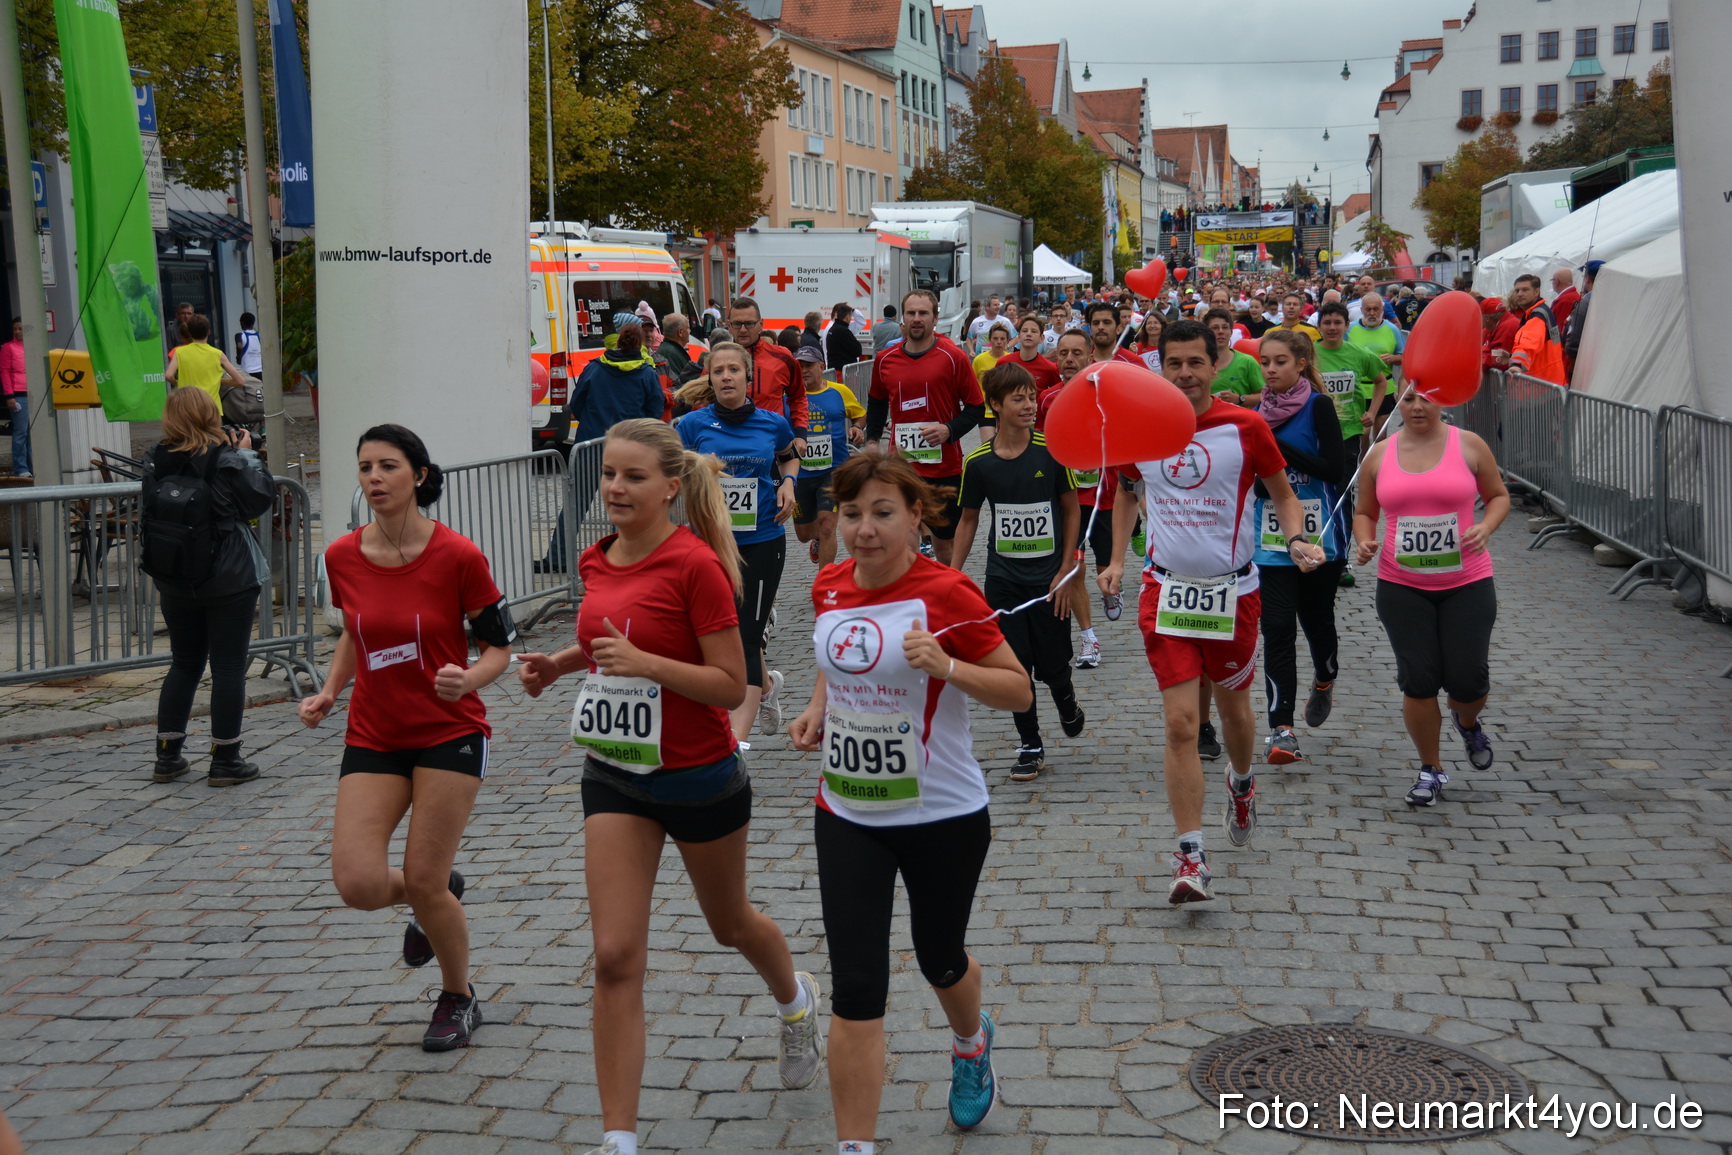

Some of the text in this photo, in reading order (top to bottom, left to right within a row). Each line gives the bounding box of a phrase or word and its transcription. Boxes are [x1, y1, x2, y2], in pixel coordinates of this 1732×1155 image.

[1226, 231, 1260, 242] START
[319, 246, 492, 266] www.bmw-laufsport.de
[797, 267, 843, 275] Bayerisches
[797, 276, 819, 284] Rotes
[1036, 275, 1067, 283] Laufsport
[797, 285, 819, 293] Kreuz
[1001, 516, 1048, 537] 5202
[1418, 520, 1449, 528] Neumarkt
[1012, 542, 1037, 551] Adrian
[1401, 528, 1456, 553] 5024
[1420, 557, 1439, 566] Lisa
[1167, 585, 1228, 613] 5051
[1172, 616, 1219, 630] Johannes
[382, 650, 404, 662] DEHN
[584, 683, 643, 697] PARTL Neumarkt
[876, 685, 908, 697] HERZ
[580, 698, 652, 738] 5040
[828, 713, 893, 734] PARTL Neumarkt
[829, 731, 907, 774] 5095
[841, 780, 888, 798] Renate
